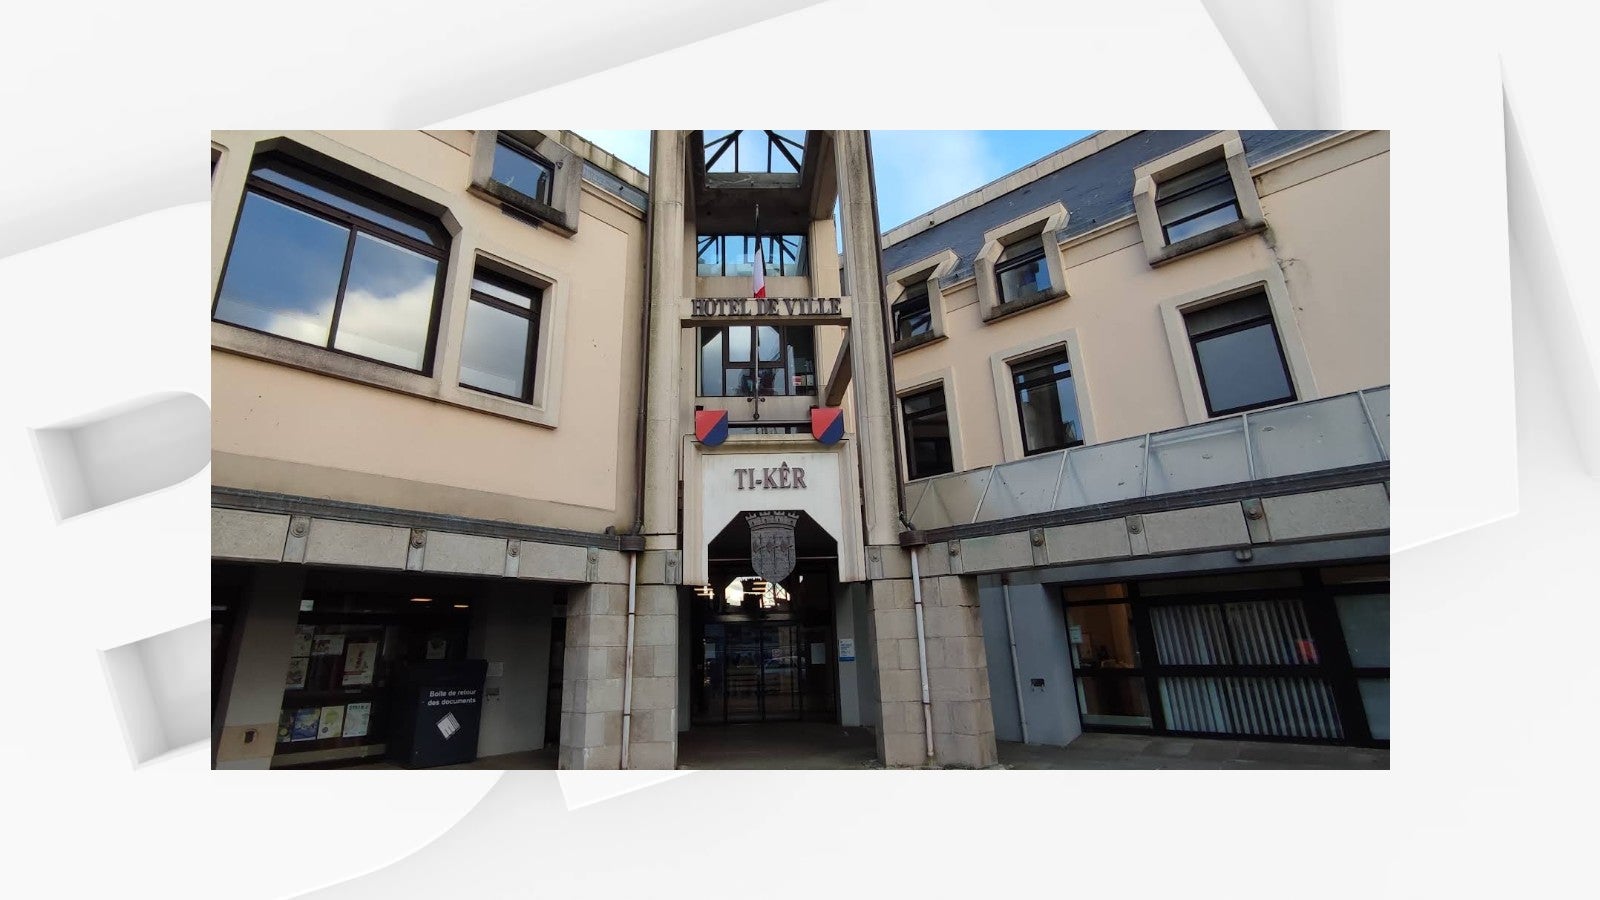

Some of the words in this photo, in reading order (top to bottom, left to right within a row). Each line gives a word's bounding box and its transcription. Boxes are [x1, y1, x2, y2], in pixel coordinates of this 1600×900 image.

[756, 298, 779, 316] DE
[782, 297, 842, 316] VILLE
[734, 461, 807, 490] TI-KÊR
[441, 697, 476, 705] documents
